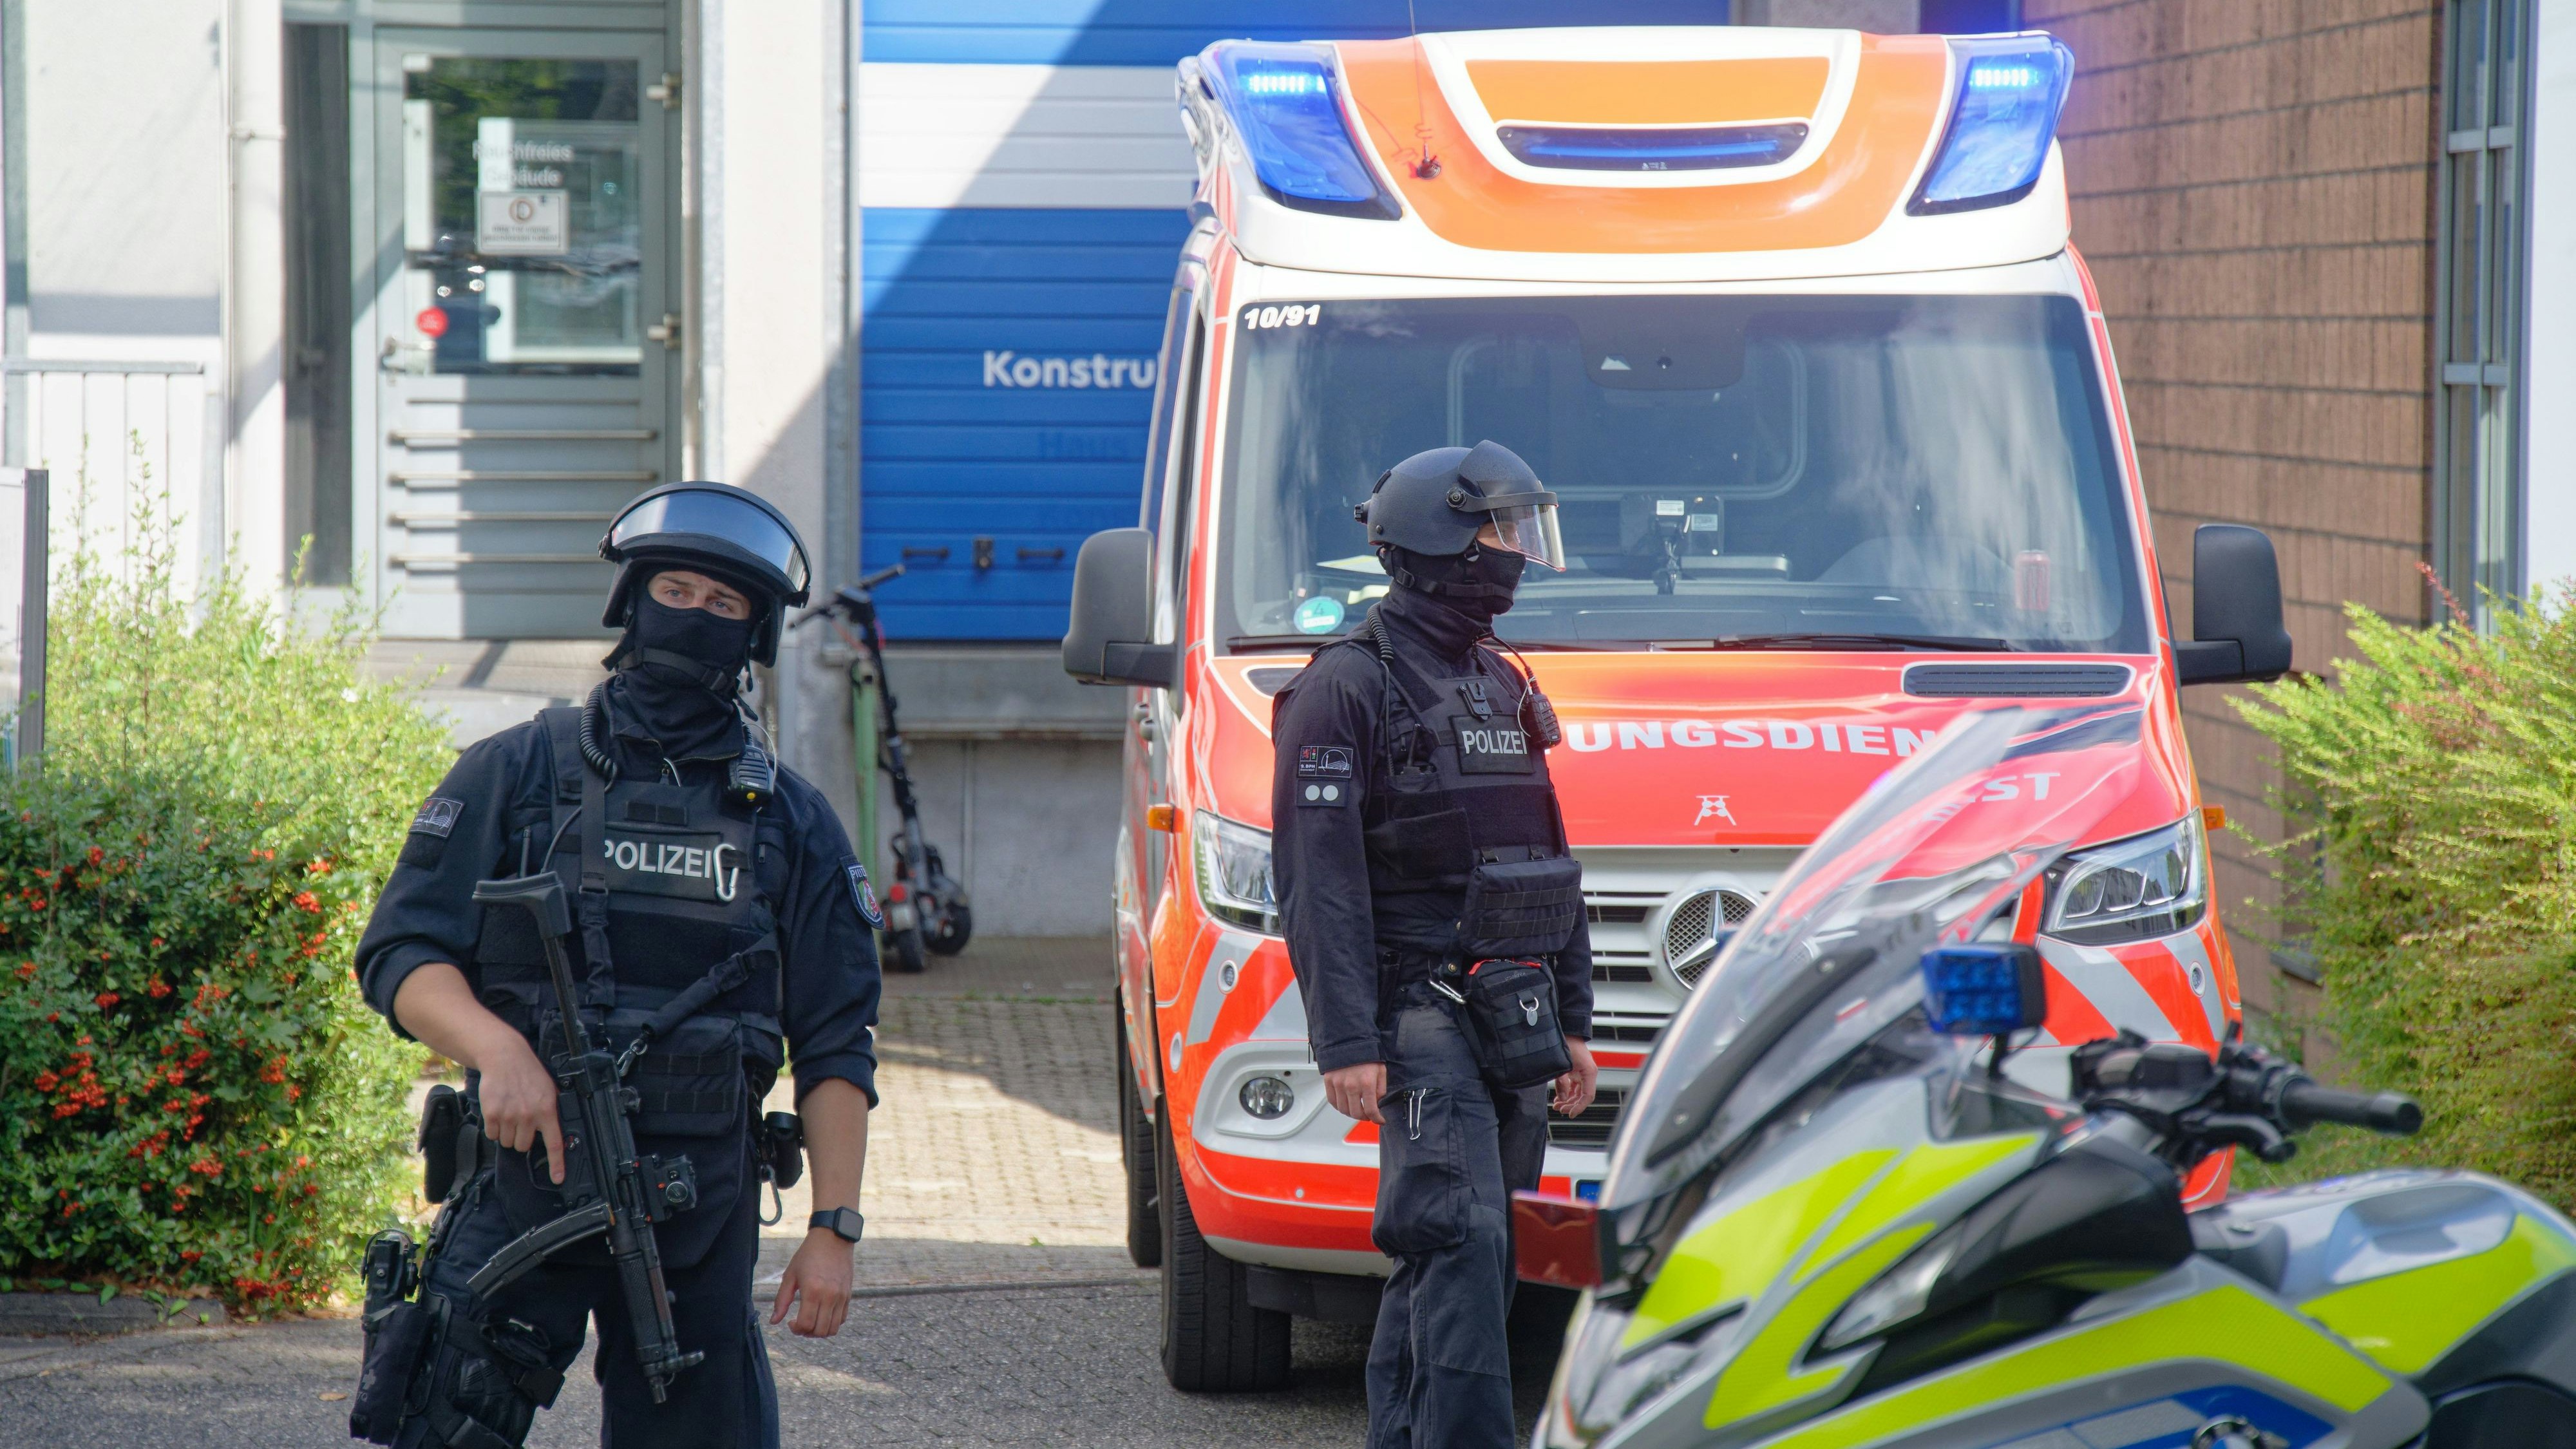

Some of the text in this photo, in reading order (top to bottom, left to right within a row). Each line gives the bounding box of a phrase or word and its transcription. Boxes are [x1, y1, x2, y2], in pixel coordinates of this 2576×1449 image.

[1244, 304, 1321, 330] 10/91
[983, 350, 1161, 388] Konstru
[1462, 730, 1528, 755] POLIZEI
